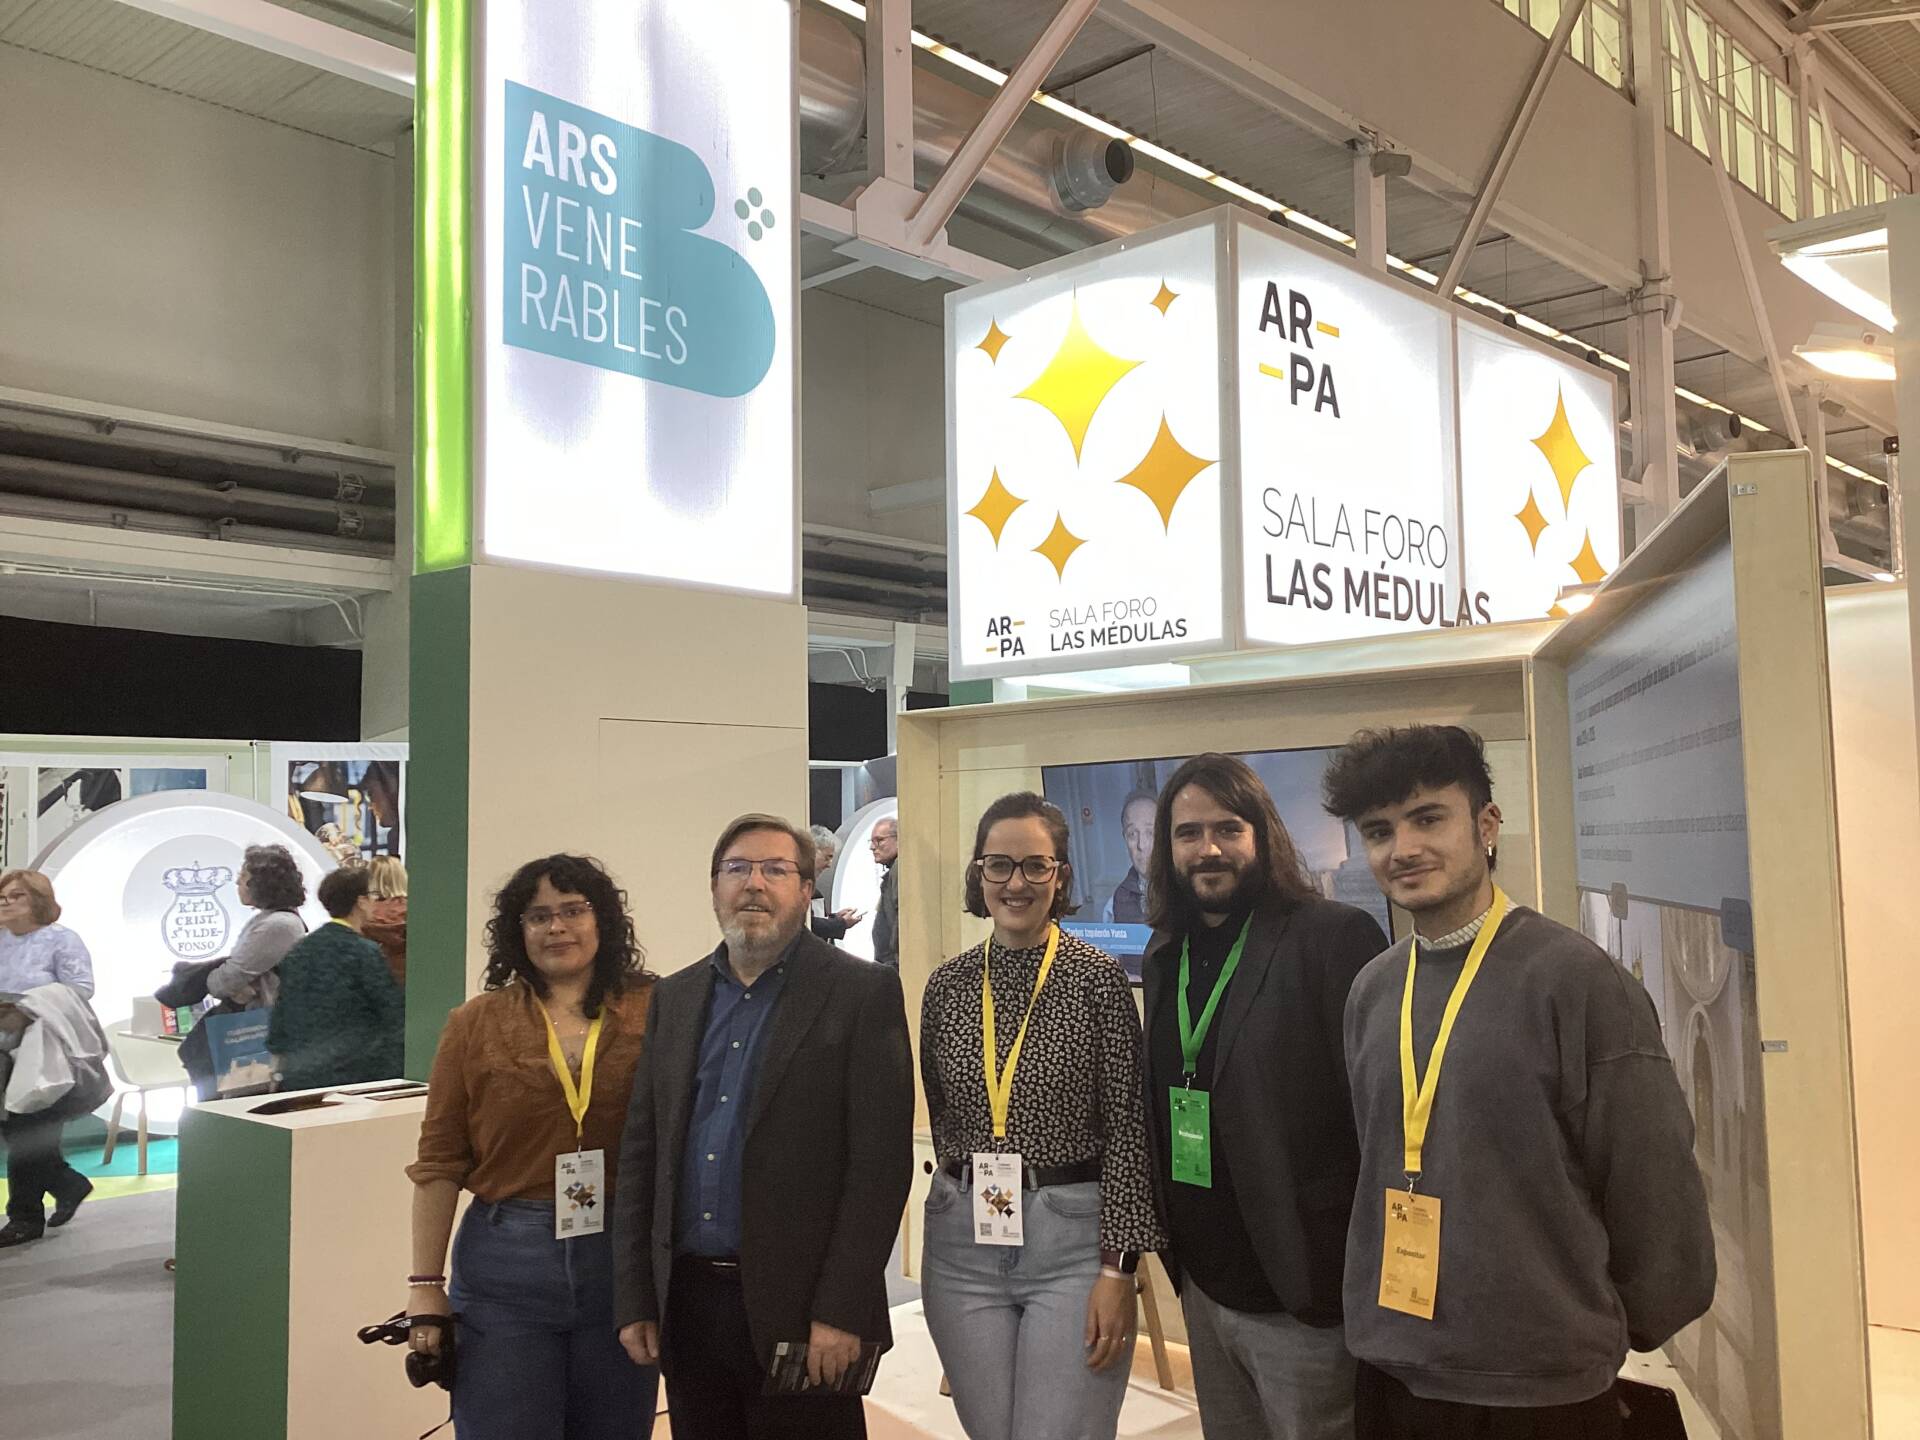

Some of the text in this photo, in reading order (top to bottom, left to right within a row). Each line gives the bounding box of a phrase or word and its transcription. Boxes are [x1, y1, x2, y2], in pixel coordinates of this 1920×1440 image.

[522, 110, 617, 196] ARS
[522, 184, 642, 281] VENE
[521, 262, 688, 365] RABLES
[1263, 487, 1448, 569] SALA FORO
[1049, 596, 1158, 628] SALA FORO
[1266, 553, 1491, 628] LAS MÉDULAS
[1050, 618, 1188, 652] LAS MÉDULAS
[178, 941, 215, 952] FONSO
